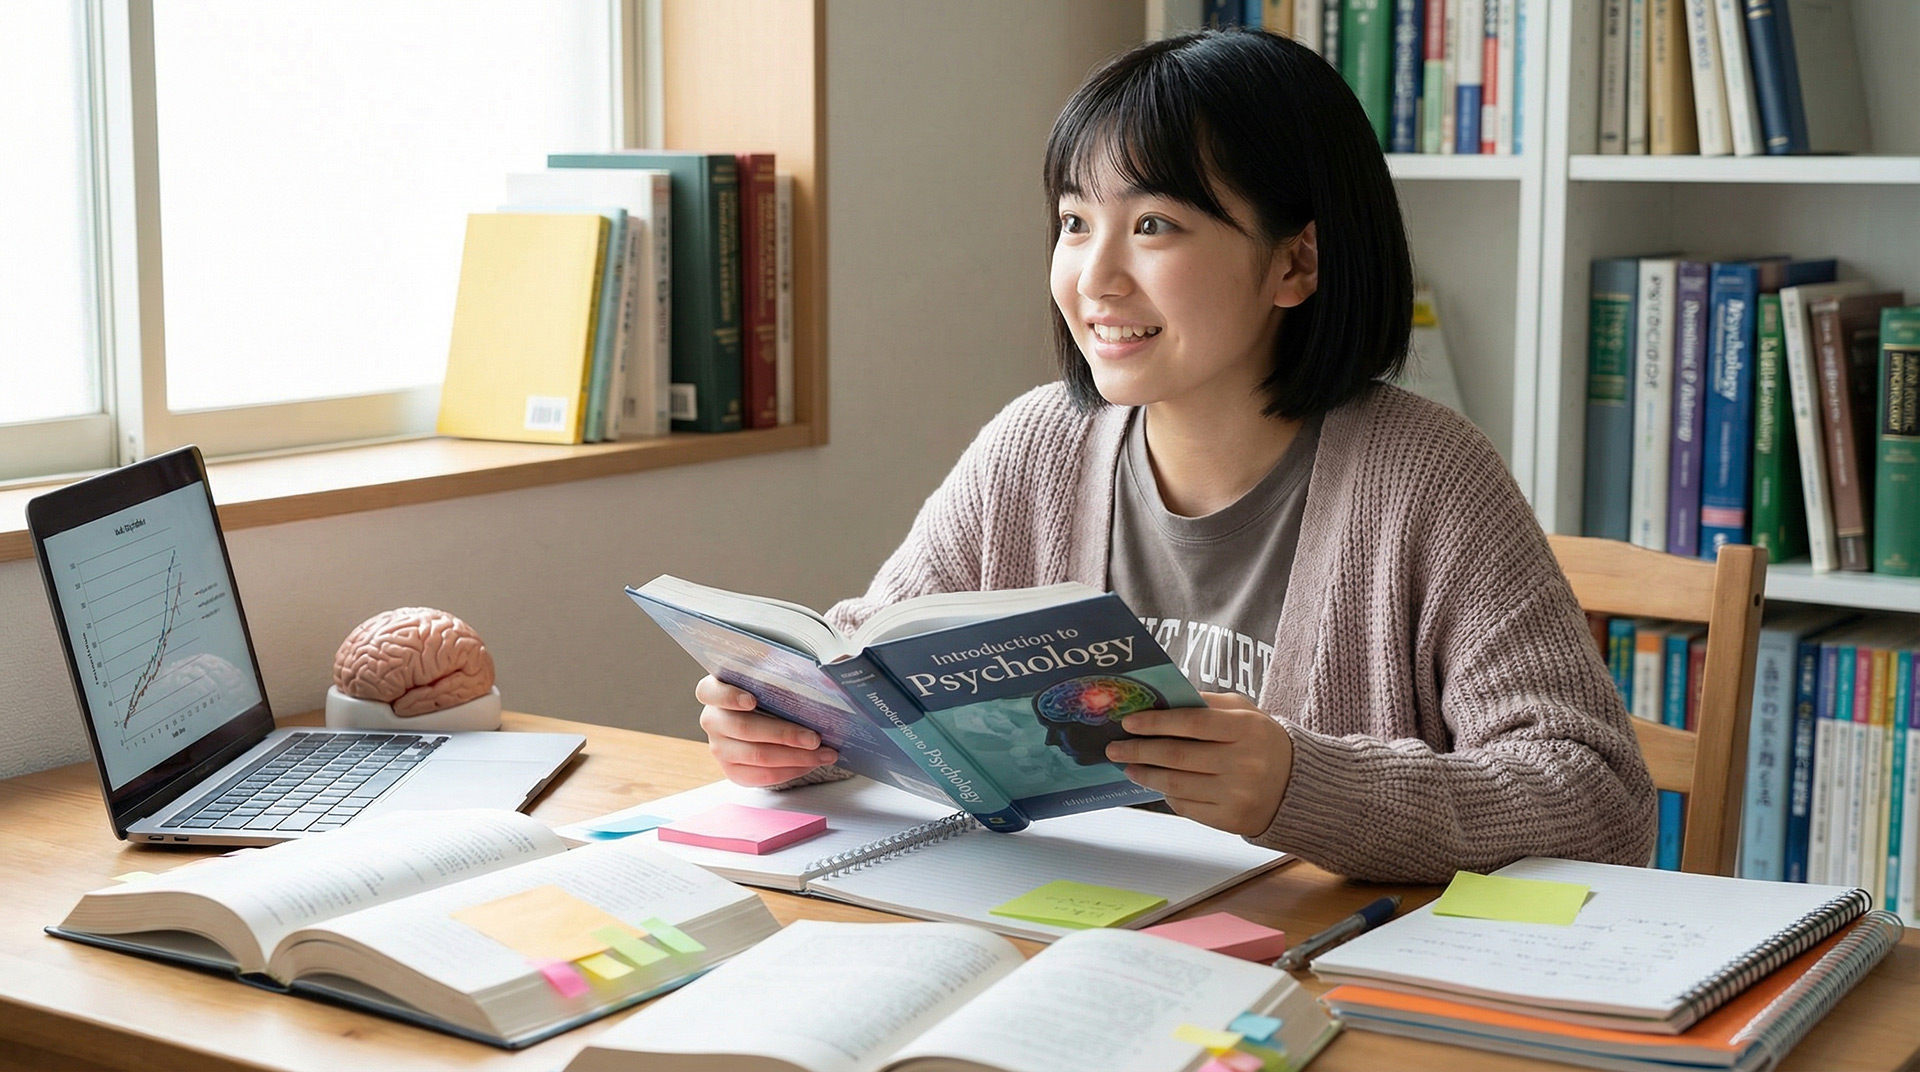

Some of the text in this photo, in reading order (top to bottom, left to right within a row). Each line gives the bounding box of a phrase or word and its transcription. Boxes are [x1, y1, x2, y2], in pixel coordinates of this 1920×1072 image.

[905, 635, 1136, 697] Psychology
[930, 626, 1079, 666] Introduction to
[914, 738, 927, 750] to
[924, 749, 984, 804] Psychology
